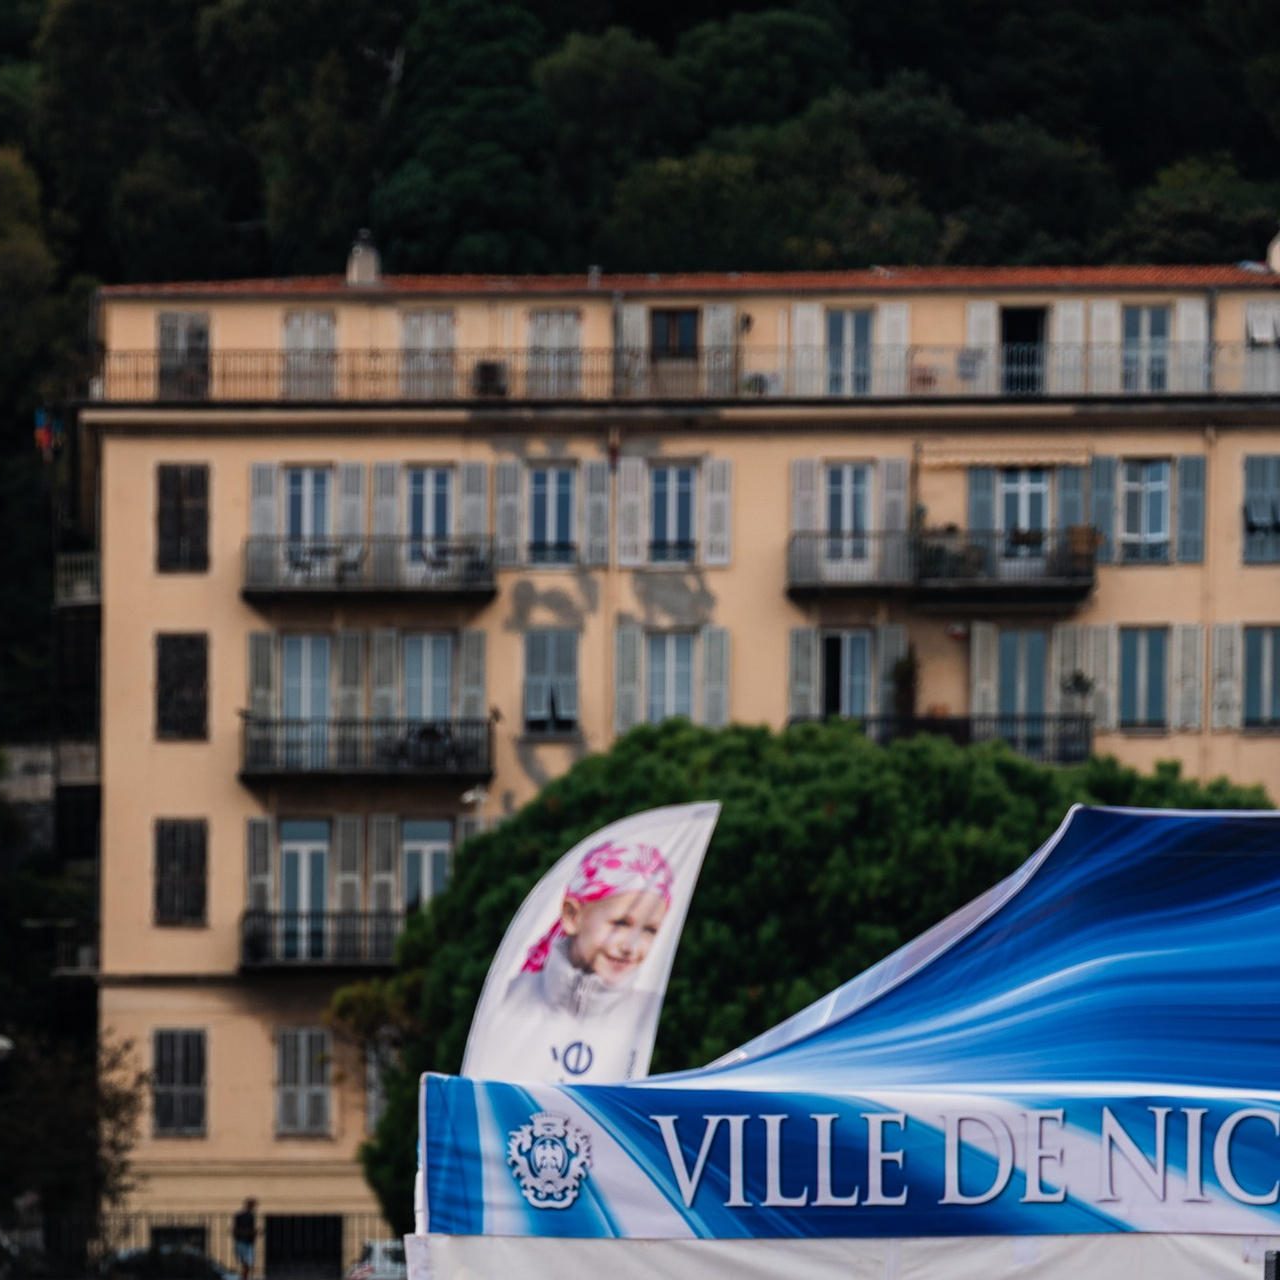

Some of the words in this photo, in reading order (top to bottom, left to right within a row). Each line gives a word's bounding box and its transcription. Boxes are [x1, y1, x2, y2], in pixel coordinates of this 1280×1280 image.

[649, 1111, 908, 1209] VILLE
[938, 1107, 1067, 1206] DE
[1098, 1105, 1280, 1205] NIC
